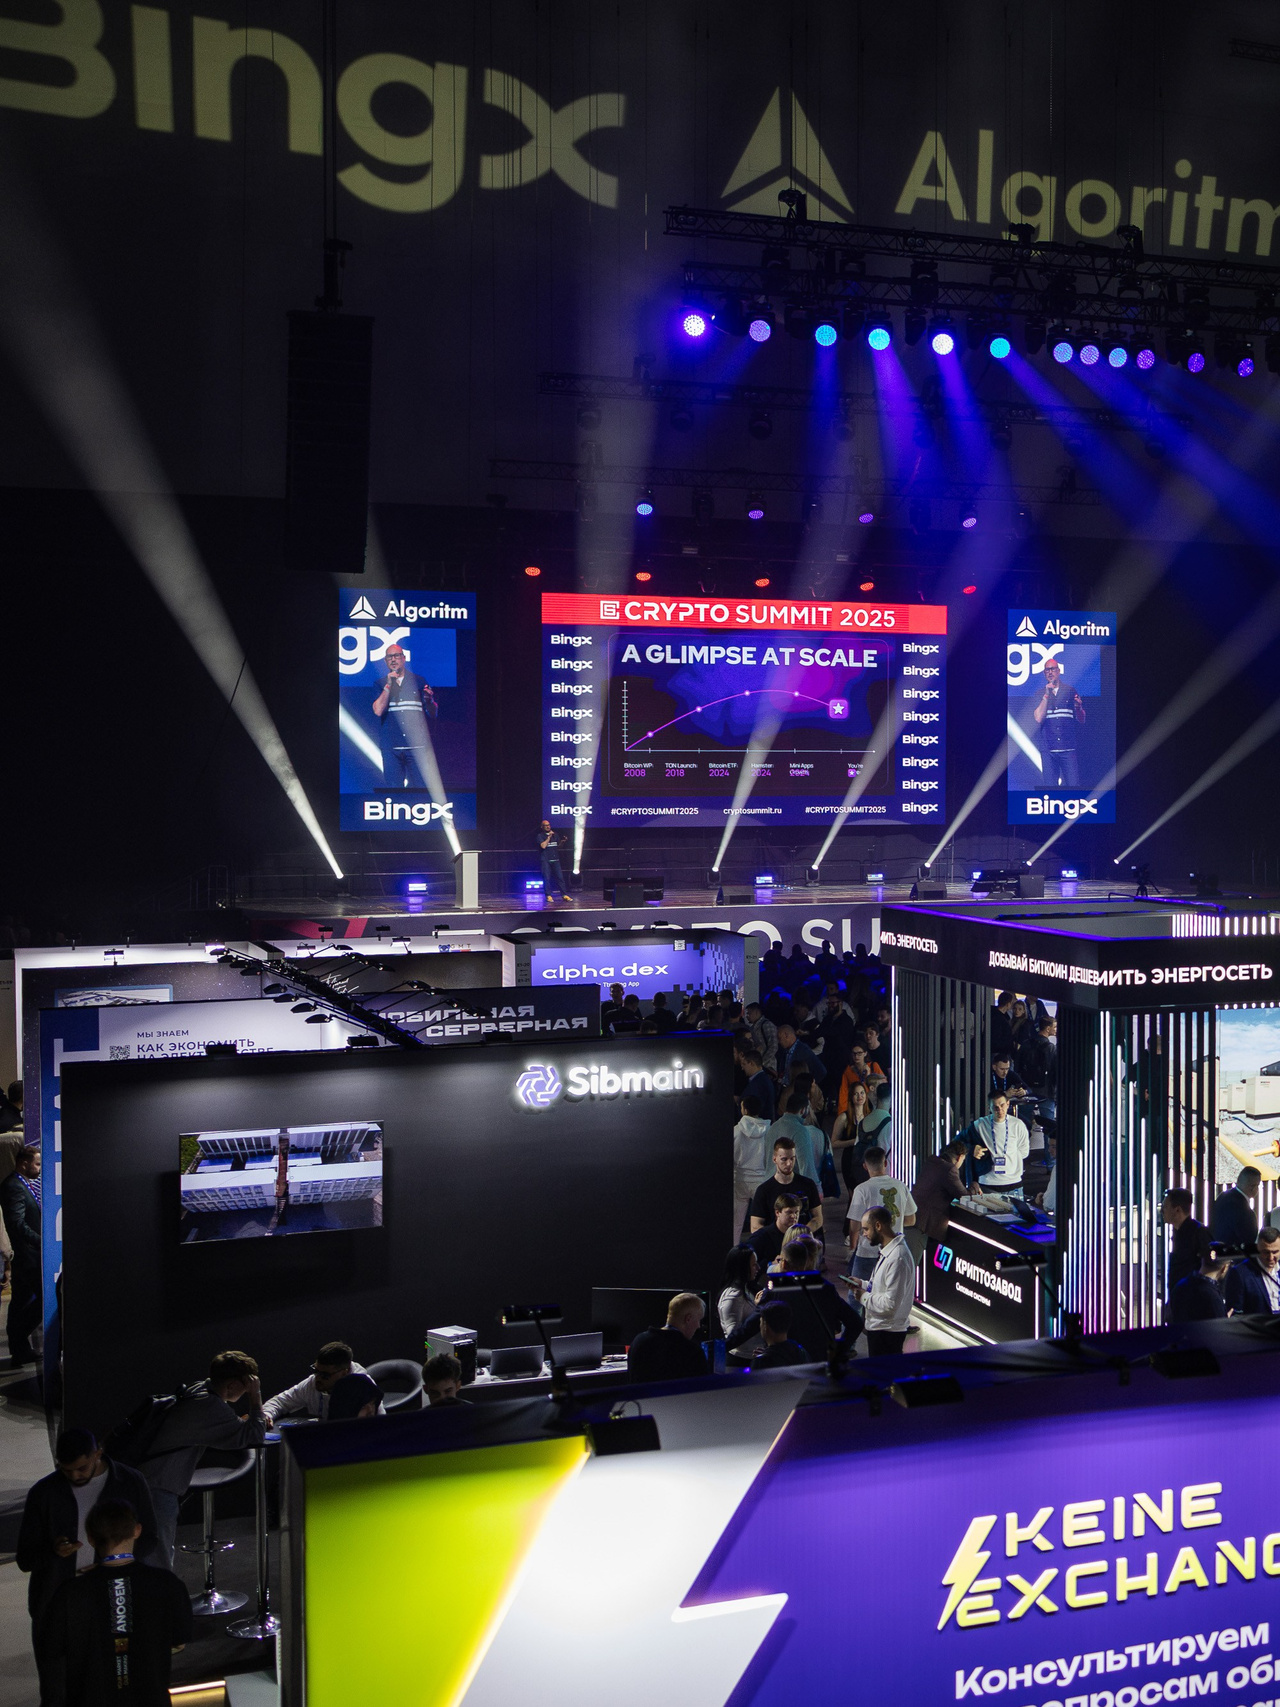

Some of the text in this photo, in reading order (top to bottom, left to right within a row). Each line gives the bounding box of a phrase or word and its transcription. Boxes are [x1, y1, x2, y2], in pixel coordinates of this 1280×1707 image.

[384, 600, 468, 623] Algoritm
[624, 601, 896, 628] CRYPTO SUMMIT 2025
[1043, 619, 1110, 640] Algoritm
[621, 644, 877, 668] A GLIMPSE AT SCALE
[624, 769, 646, 777] 2008
[665, 769, 685, 777] 2018
[709, 769, 729, 777] 2024
[751, 769, 771, 777] 2024
[611, 807, 699, 816] #CRYPTOSUMMIT2025
[805, 806, 886, 814] #CRYPTOSUMMIT2025
[897, 934, 938, 954] ЭНЕРГОСЕТЬ
[542, 962, 669, 981] alpha dex
[989, 950, 1028, 972] ДОБЫВАЙ
[1029, 958, 1068, 980] БИТКОИН
[1151, 964, 1273, 984] ЭНЕРГОСЕТЬ
[137, 1029, 189, 1039] МЫ ЗНАЕМ
[426, 1016, 588, 1038] СЕРВЕРНАЯ
[137, 1043, 164, 1054] КАК
[567, 1061, 704, 1096] Sibmain
[955, 1257, 1022, 1303] КРИПТОЗАВОД
[1006, 1481, 1223, 1557] KEINE
[114, 1577, 127, 1633] ANOGEM
[955, 1622, 1269, 1699] Консультируем
